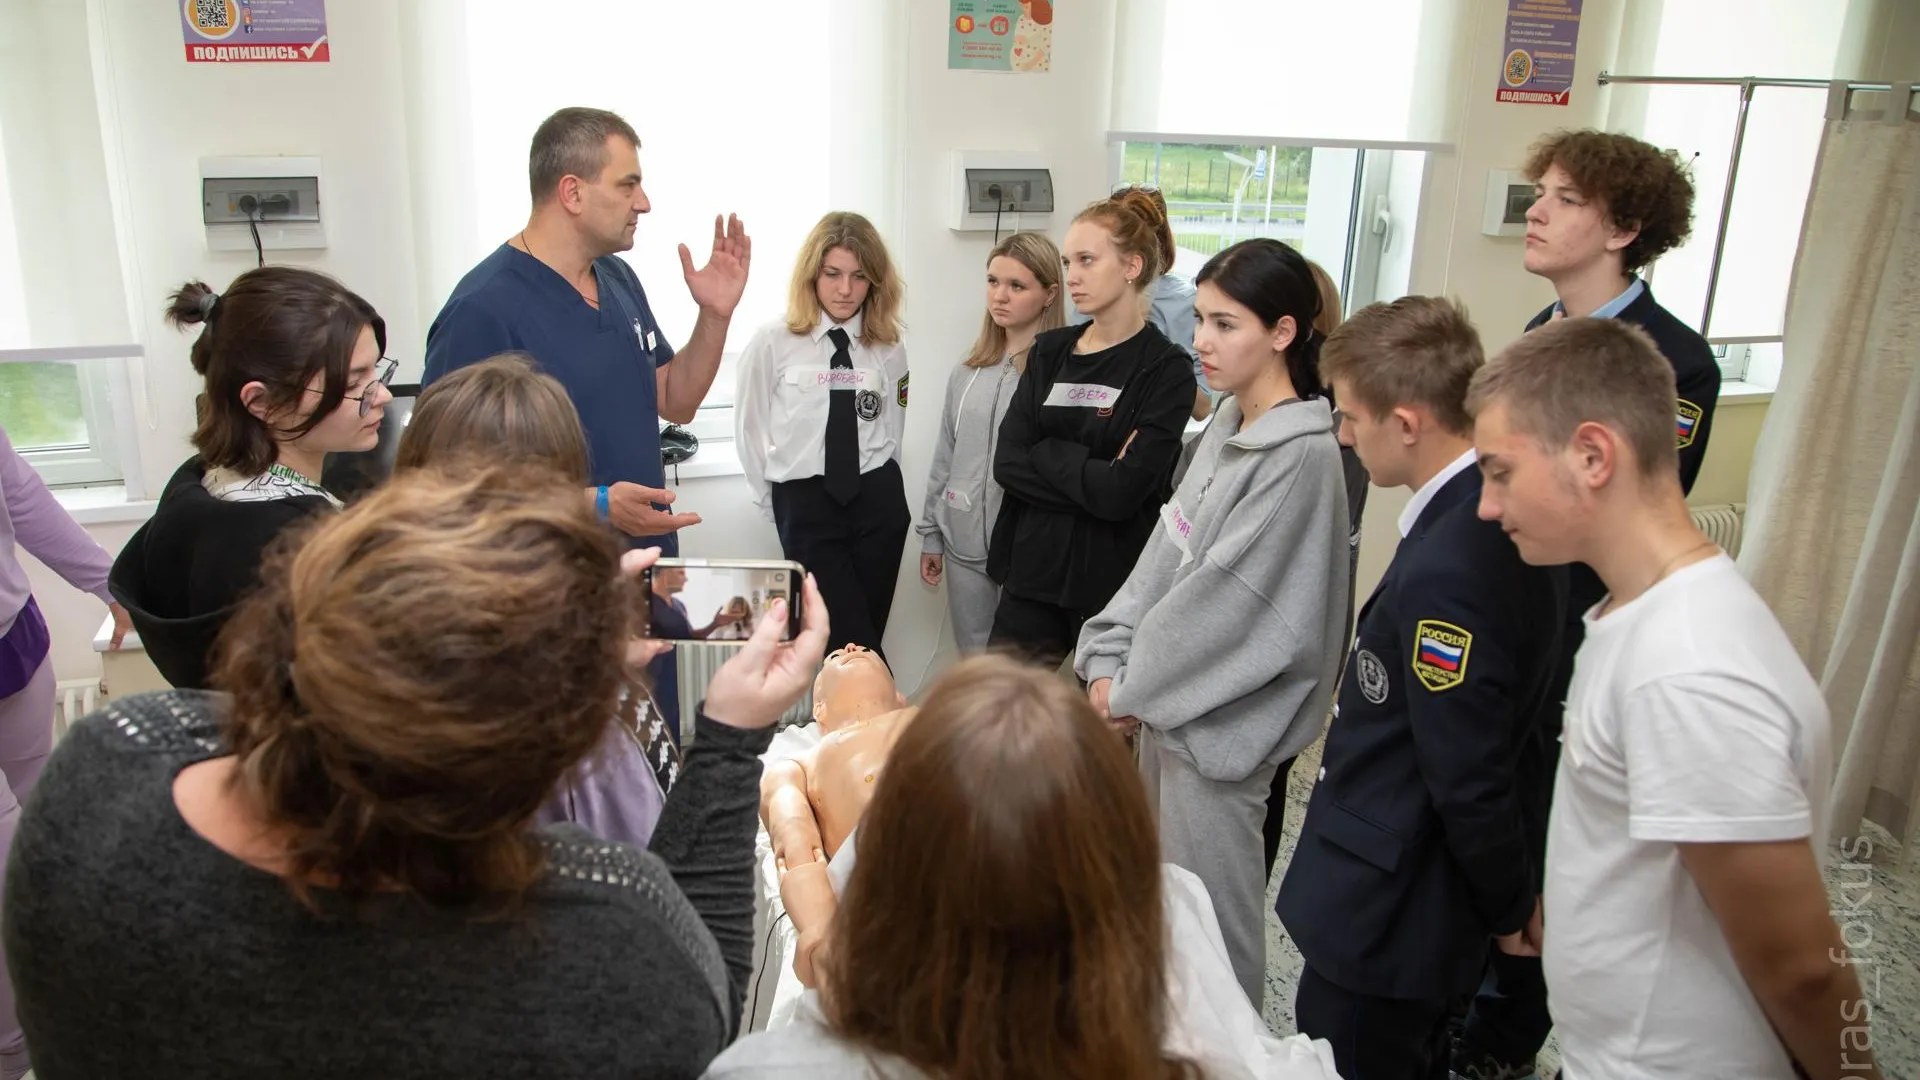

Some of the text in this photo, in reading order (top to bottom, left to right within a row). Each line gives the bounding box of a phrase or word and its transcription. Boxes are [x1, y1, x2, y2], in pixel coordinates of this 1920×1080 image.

[193, 46, 298, 61] ПОДПИШИСЬ
[1500, 91, 1553, 103] ПОДПИШИСЬ
[817, 372, 866, 385] ВОРОБЕЙ
[1421, 626, 1467, 647] РОССИЯ
